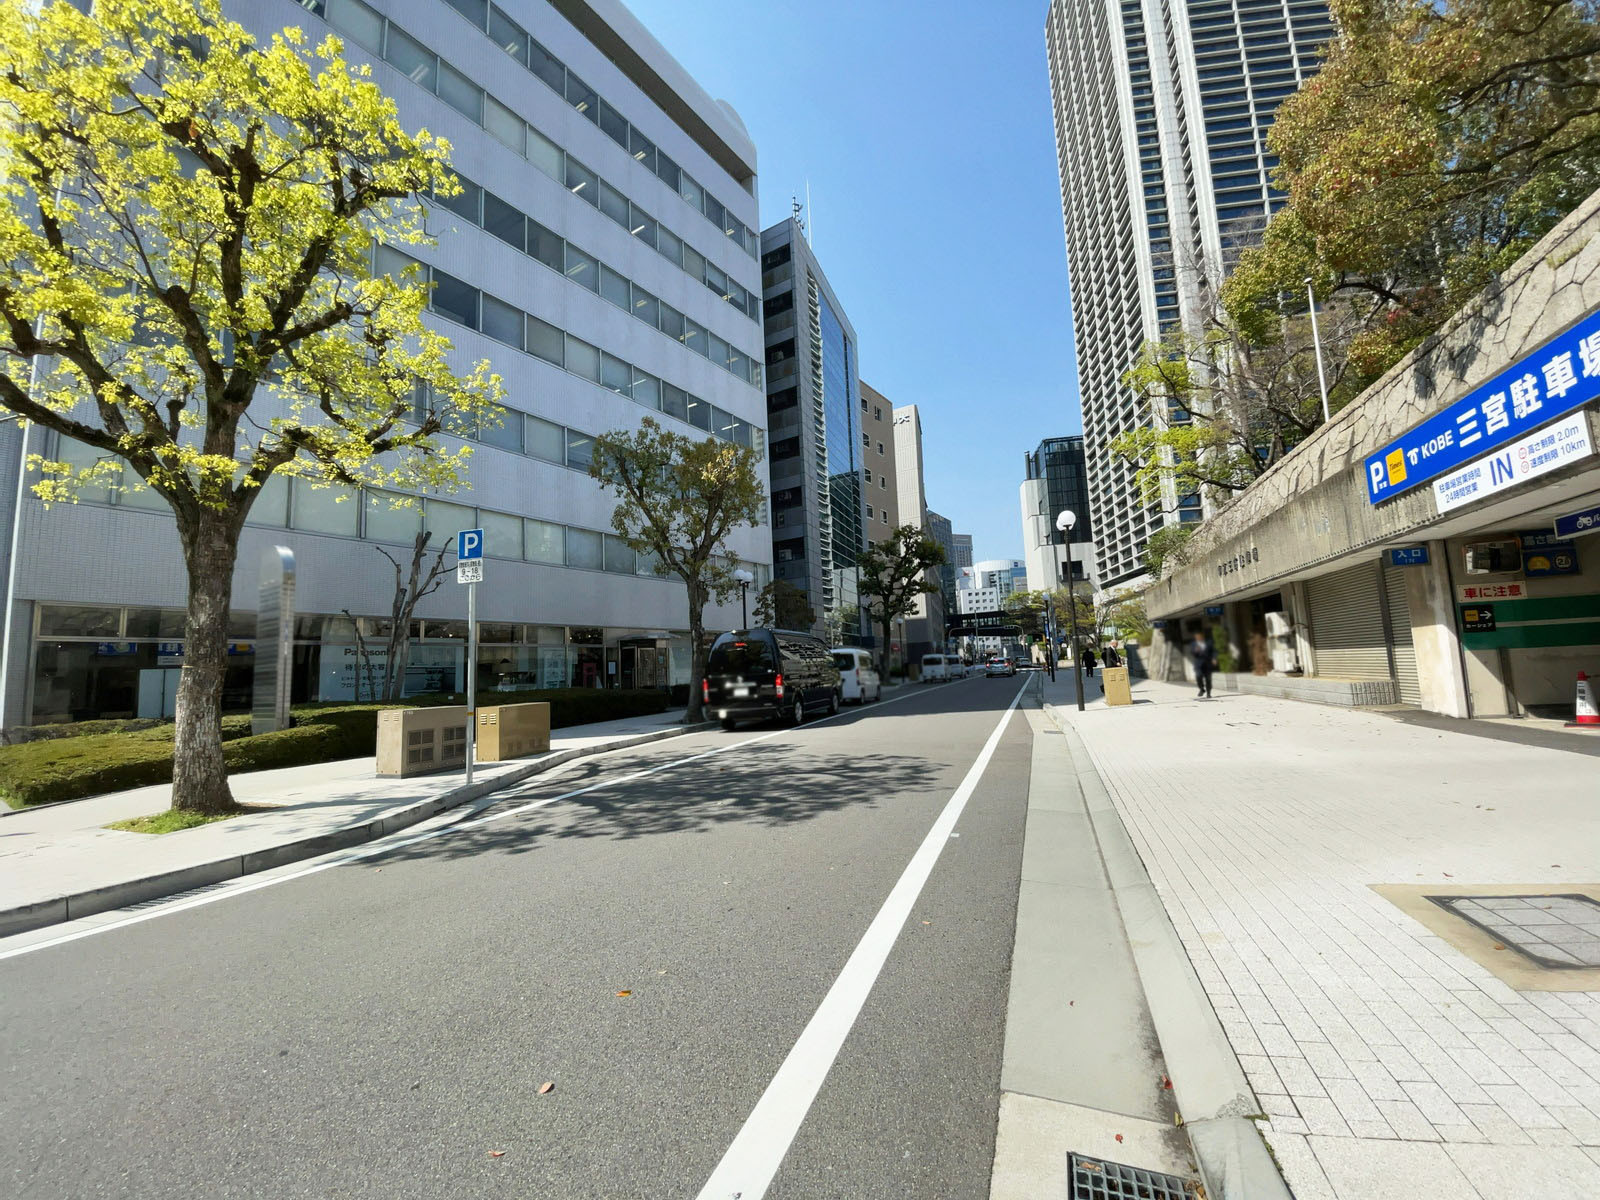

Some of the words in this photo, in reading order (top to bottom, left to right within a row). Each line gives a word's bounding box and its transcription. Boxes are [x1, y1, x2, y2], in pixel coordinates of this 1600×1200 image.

[1421, 430, 1454, 459] KOBE
[1456, 329, 1600, 448] 三宮駐車場
[1528, 435, 1556, 455] 高さ制限
[1558, 425, 1580, 442] 2.0m
[1530, 449, 1559, 469] 速度制限
[1561, 439, 1586, 455] 10km
[1369, 461, 1384, 495] P
[1489, 452, 1514, 487] IN
[1445, 482, 1479, 504] 24時間営業
[464, 533, 479, 557] P
[1397, 549, 1422, 559] 入口
[1463, 584, 1522, 600] 車に注意
